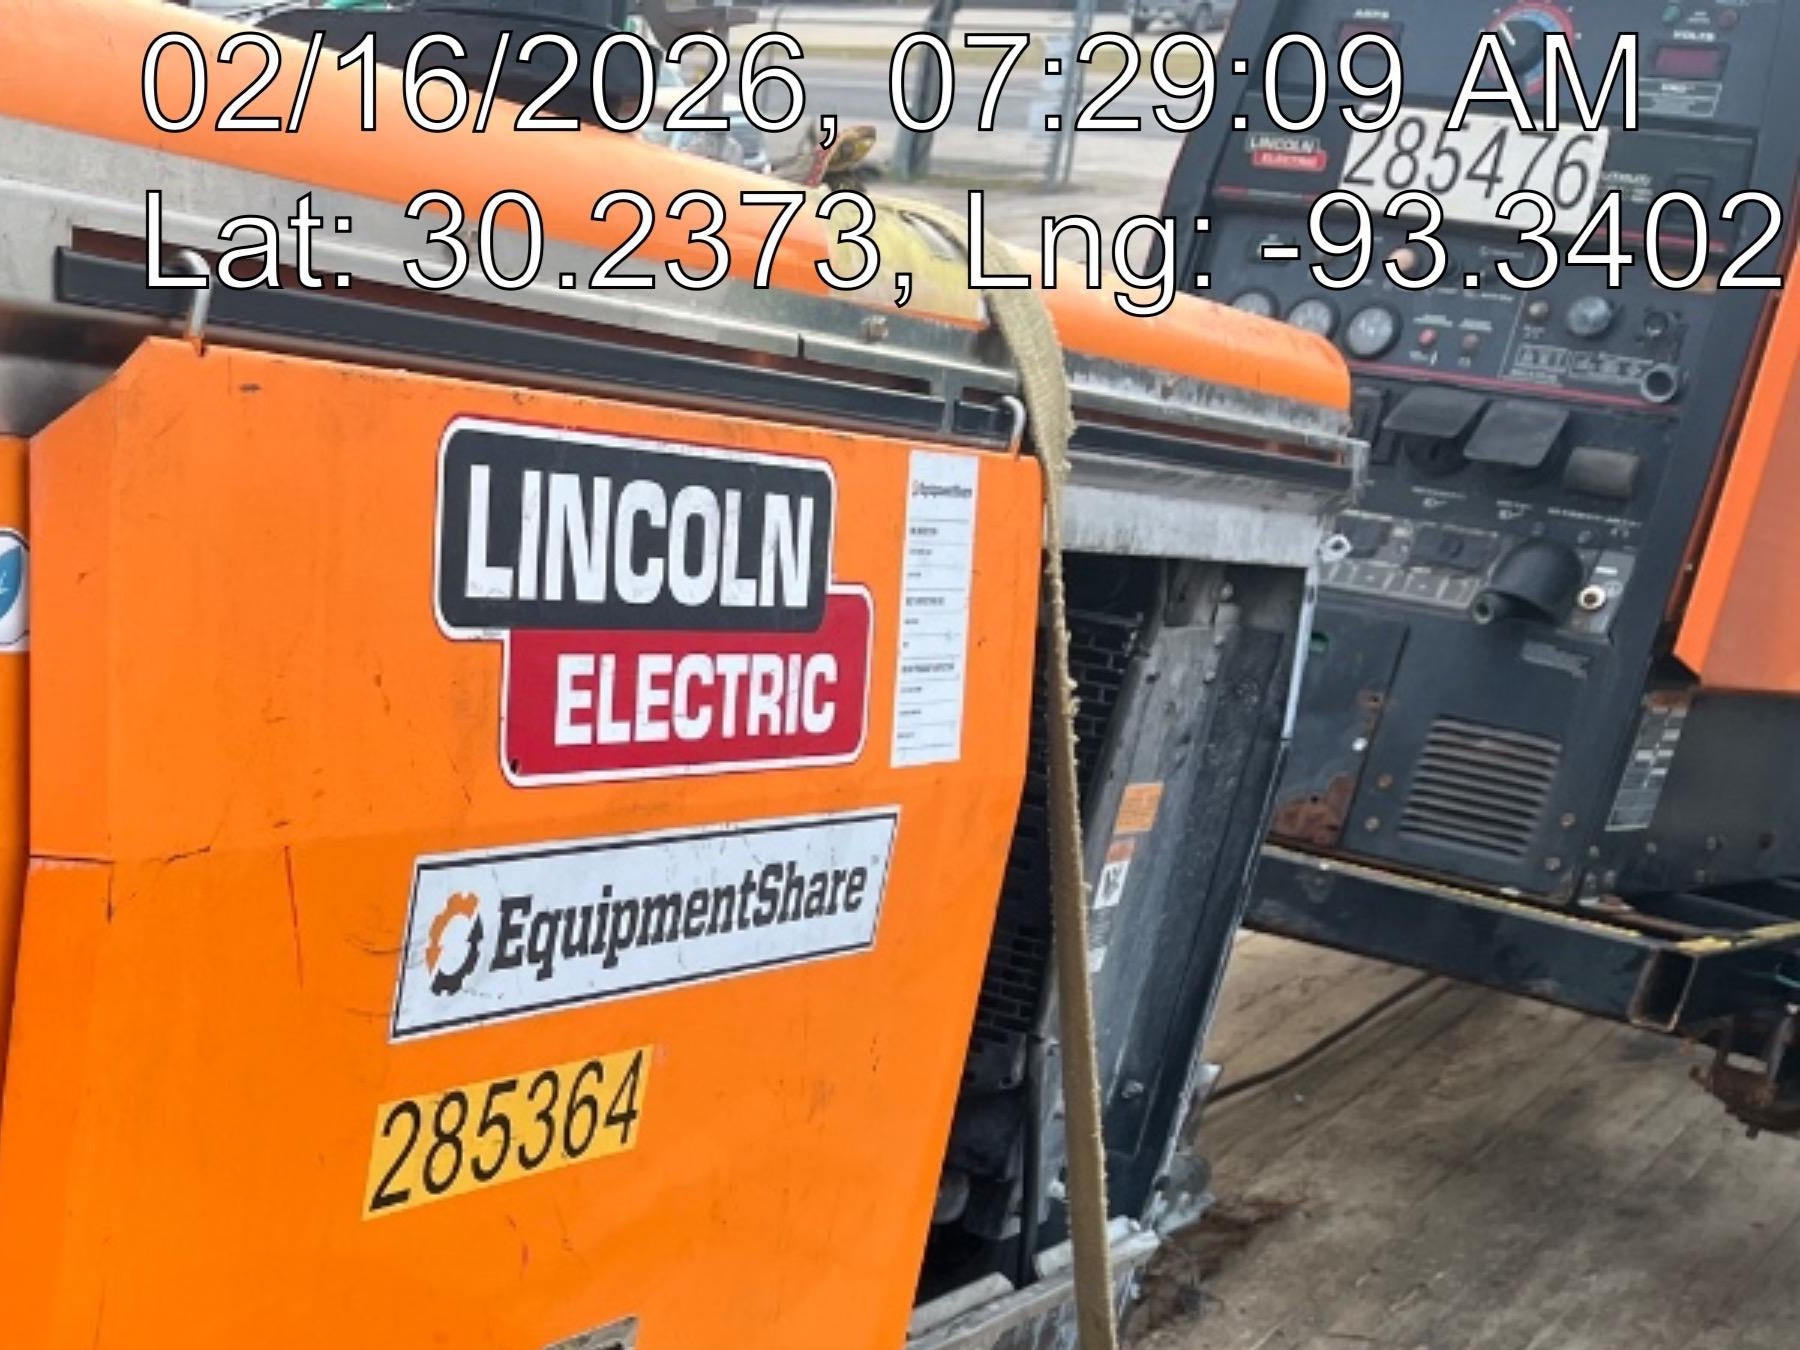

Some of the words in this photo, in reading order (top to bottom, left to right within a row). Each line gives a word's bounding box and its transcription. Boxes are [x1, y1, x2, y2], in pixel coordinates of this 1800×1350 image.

[1342, 110, 1595, 210] 285476
[463, 464, 815, 608] LINCOLN
[553, 652, 838, 747] ELECTRIC
[488, 859, 868, 982] EquipmentShare
[368, 1049, 646, 1213] 285364
